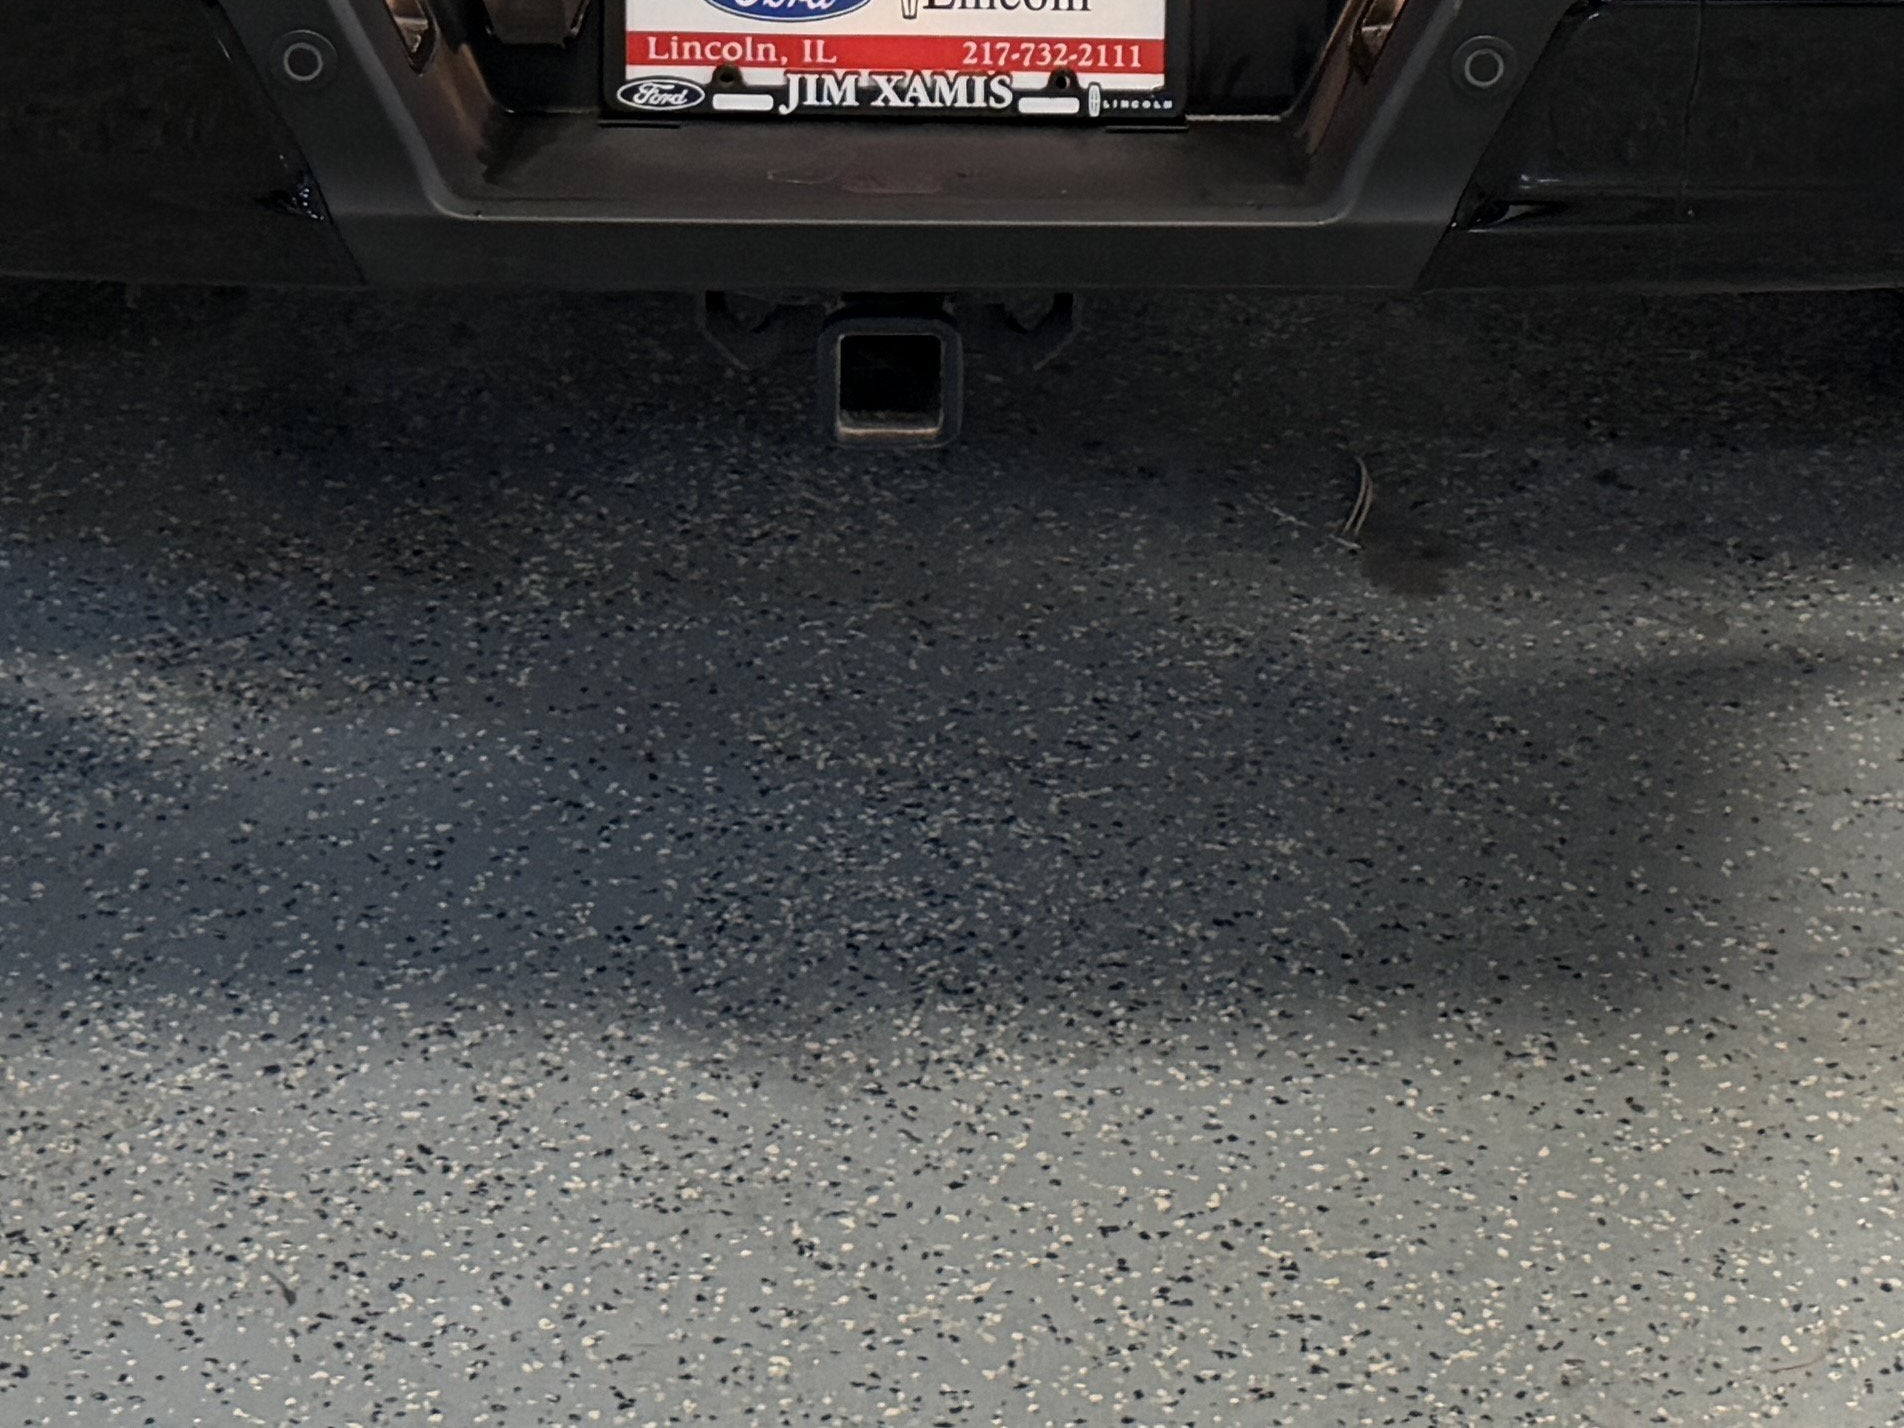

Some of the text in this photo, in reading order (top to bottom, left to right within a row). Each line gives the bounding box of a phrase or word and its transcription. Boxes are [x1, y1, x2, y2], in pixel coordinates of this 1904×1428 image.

[646, 35, 838, 66] Lincoln, IL
[962, 41, 1142, 68] 217-732-2111
[633, 82, 688, 105] Ford
[779, 73, 1015, 115] JIM XAMIS
[1102, 99, 1173, 110] LINCOLN
